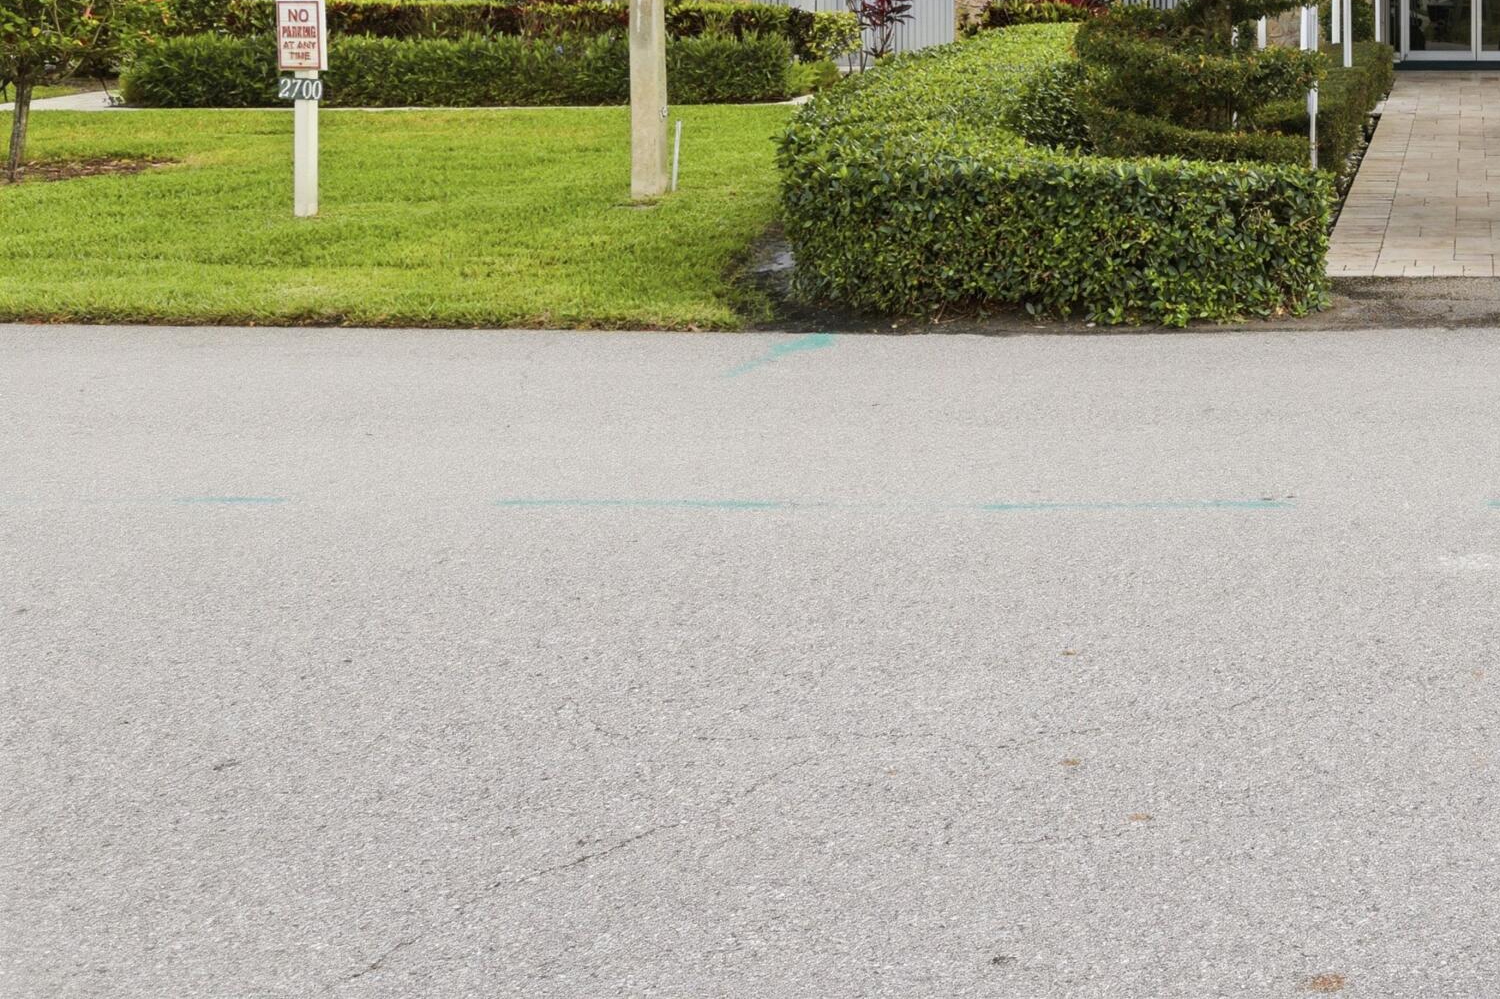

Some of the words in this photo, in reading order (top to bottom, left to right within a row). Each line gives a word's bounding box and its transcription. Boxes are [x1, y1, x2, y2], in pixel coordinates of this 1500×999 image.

[288, 9, 309, 22] NO
[282, 26, 316, 38] PARKING
[283, 41, 295, 49] AT
[297, 41, 316, 50] ANY
[289, 52, 311, 61] TIME
[279, 79, 322, 99] 2700
